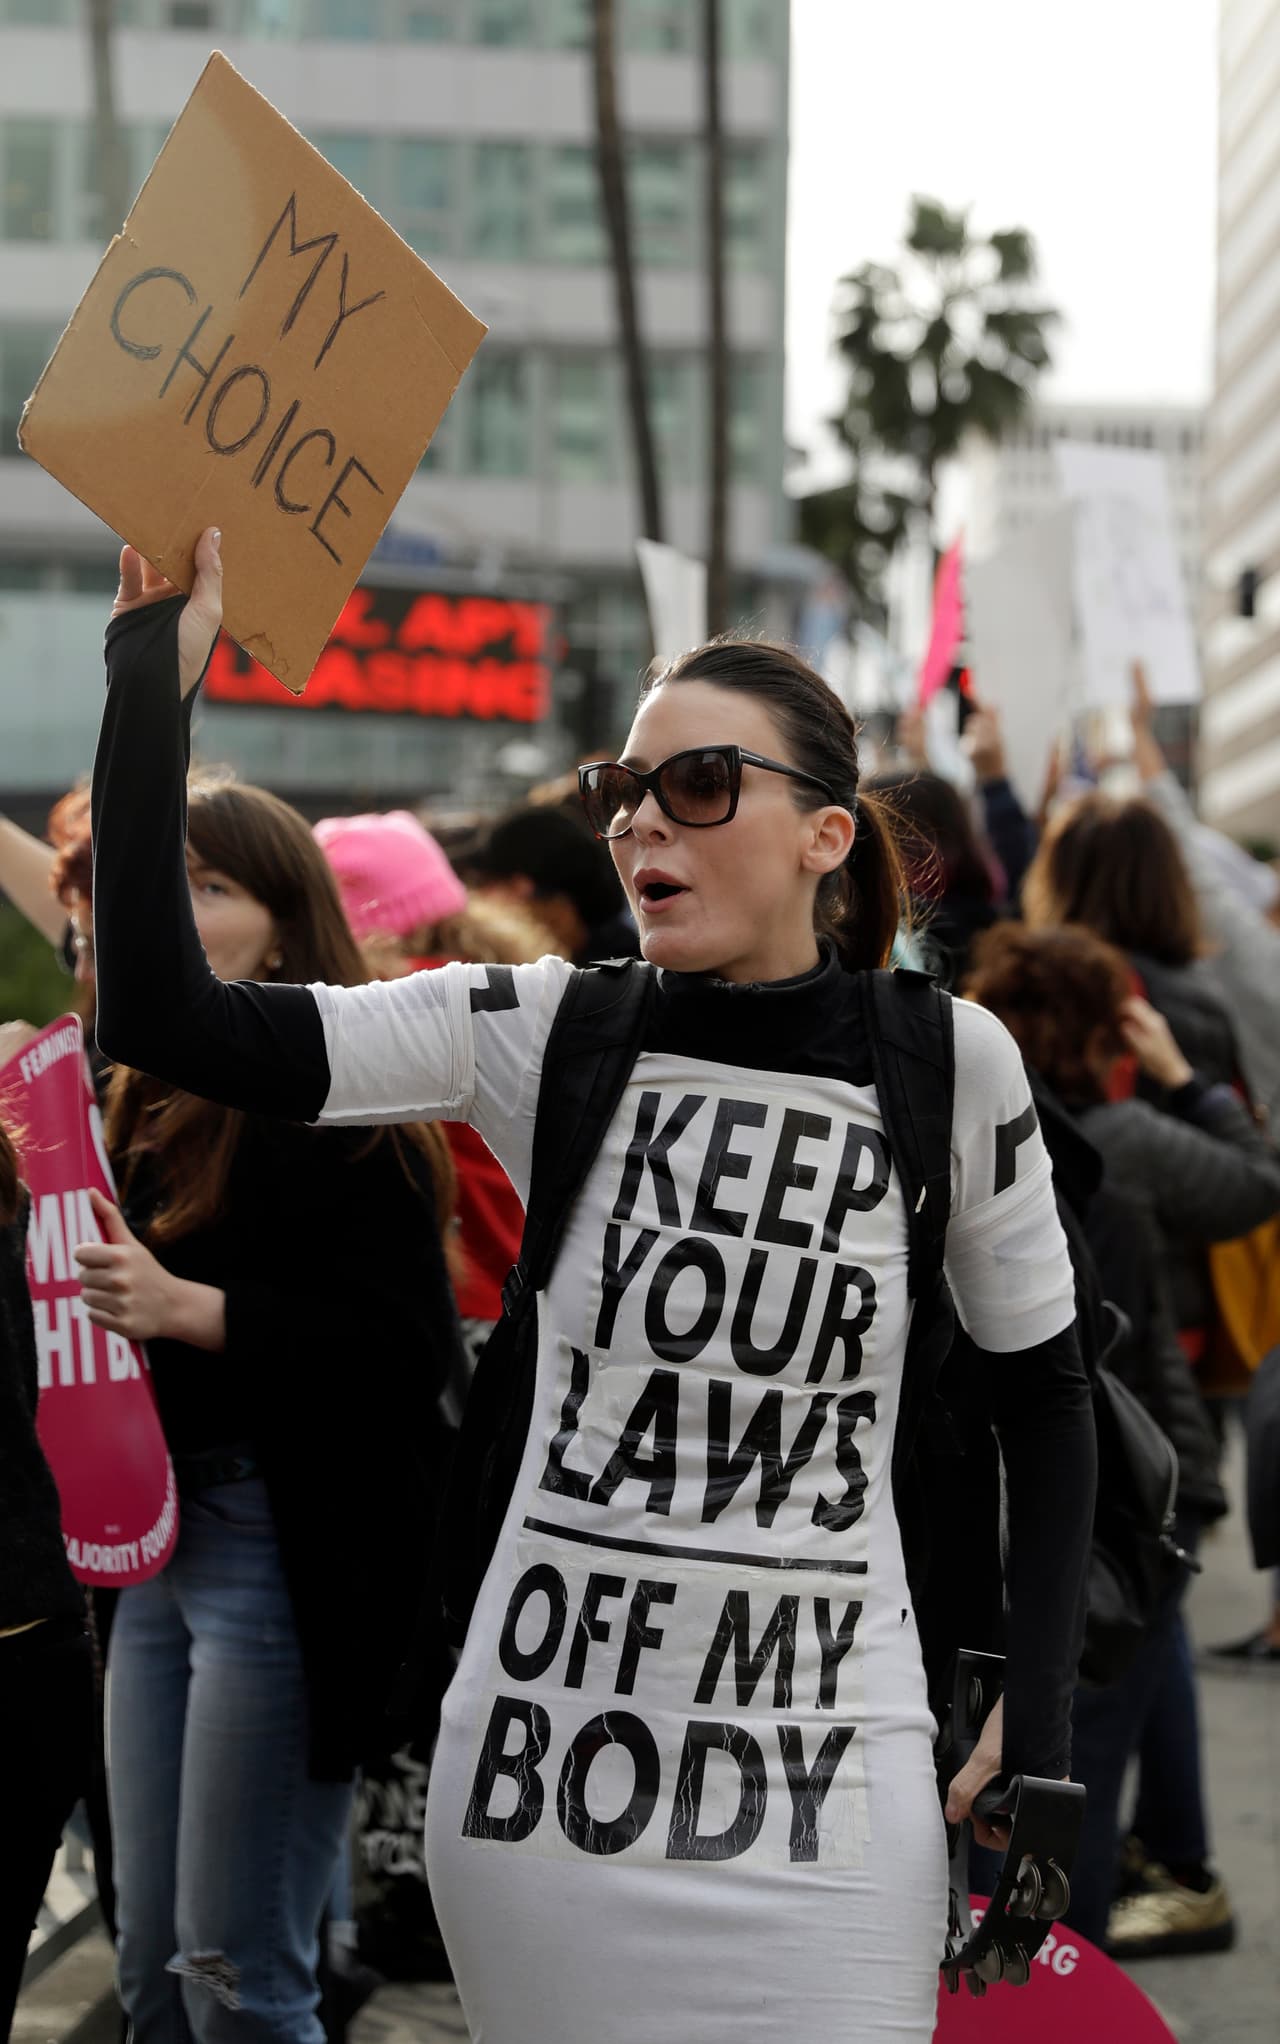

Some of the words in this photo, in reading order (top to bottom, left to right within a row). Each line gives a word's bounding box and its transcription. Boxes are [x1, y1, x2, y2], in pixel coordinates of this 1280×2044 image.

[238, 192, 387, 370] MY
[109, 266, 384, 566] CHOICE
[204, 628, 551, 722] LASING
[611, 1090, 892, 1254] KEEP
[594, 1222, 878, 1385] YOUR
[540, 1345, 877, 1532] LAWS
[499, 1562, 678, 1696] OFF
[693, 1589, 864, 1710] MY
[461, 1695, 857, 1863] BODY
